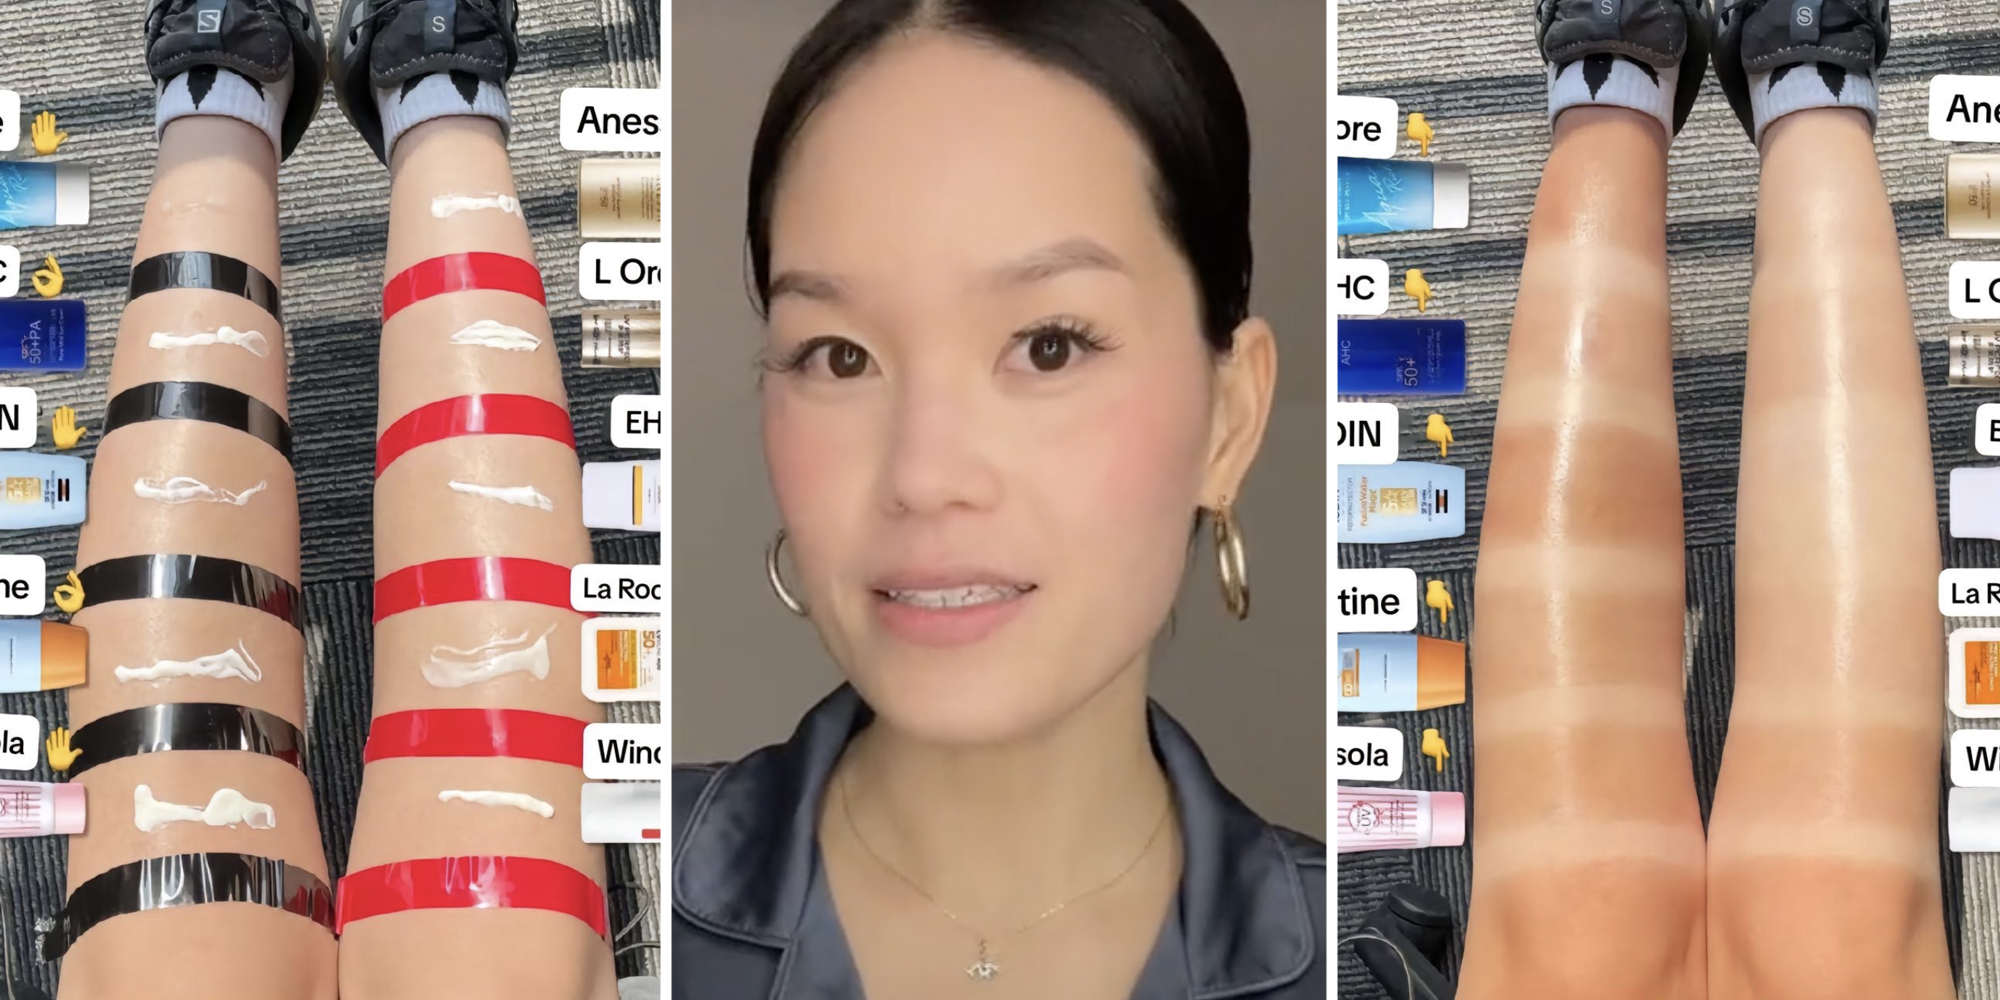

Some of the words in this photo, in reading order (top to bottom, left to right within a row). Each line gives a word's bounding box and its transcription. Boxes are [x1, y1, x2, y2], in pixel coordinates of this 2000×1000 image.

[432, 16, 445, 33] S
[29, 320, 41, 365] 50+PA
[1341, 339, 1351, 366] AHC
[1404, 358, 1418, 387] 50+
[1361, 808, 1372, 827] UV
